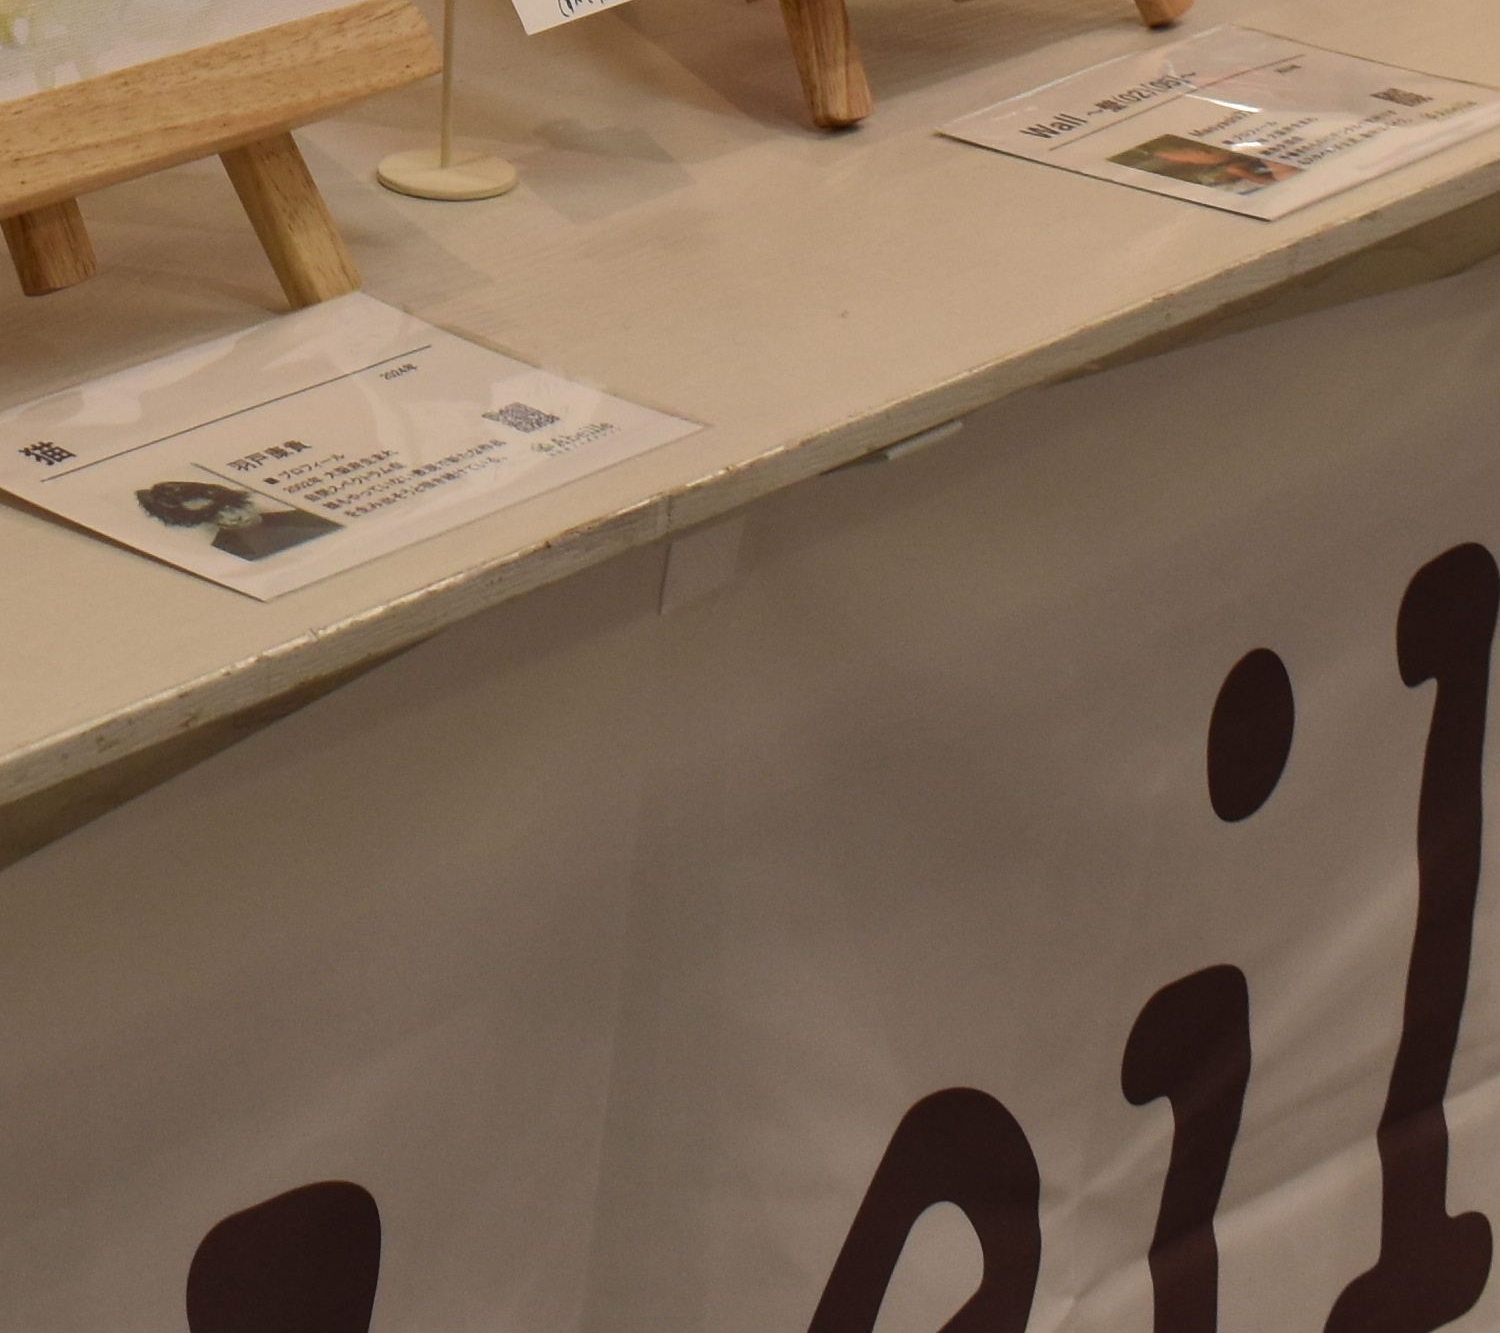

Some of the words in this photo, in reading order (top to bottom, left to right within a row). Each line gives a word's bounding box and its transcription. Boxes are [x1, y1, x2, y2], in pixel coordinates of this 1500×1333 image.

[1025, 114, 1082, 138] Wall
[24, 440, 70, 465] 猫
[278, 451, 345, 480] プロフィール
